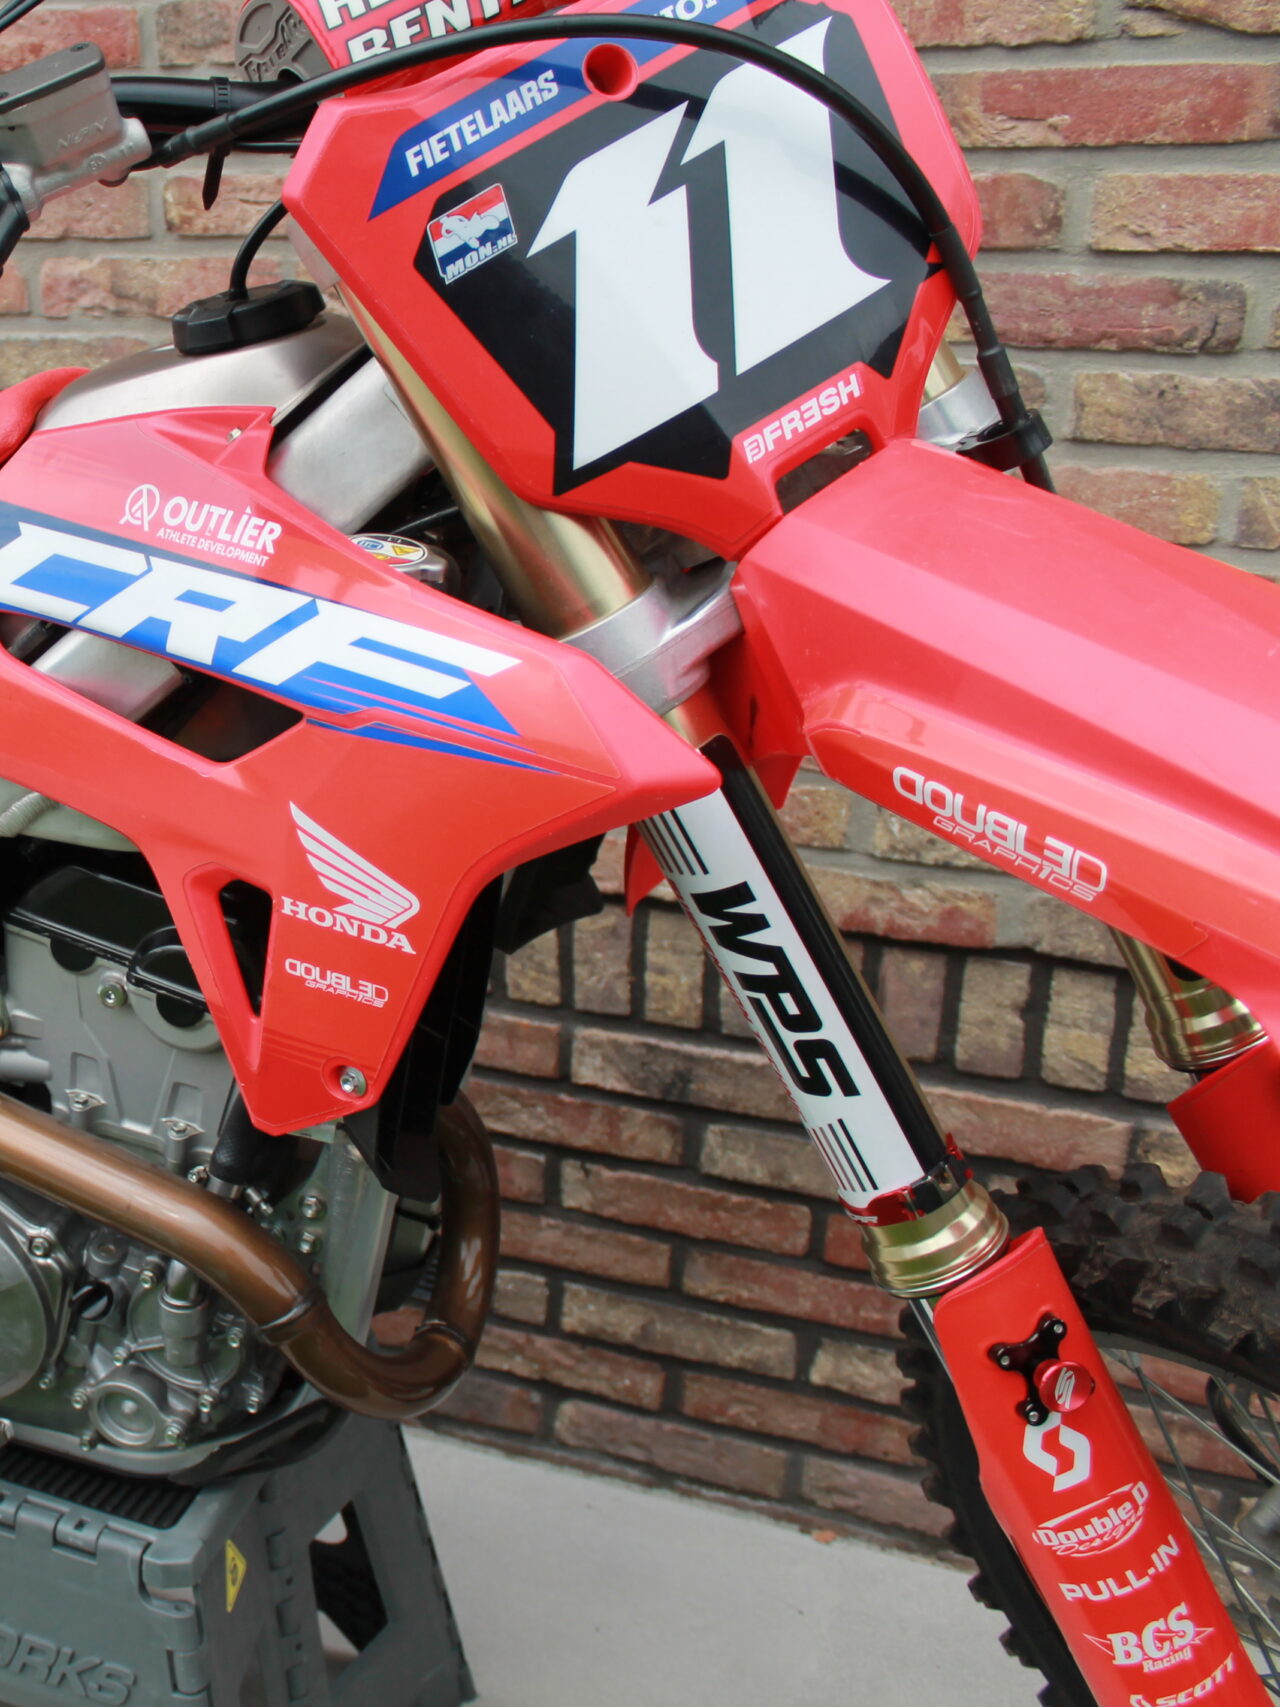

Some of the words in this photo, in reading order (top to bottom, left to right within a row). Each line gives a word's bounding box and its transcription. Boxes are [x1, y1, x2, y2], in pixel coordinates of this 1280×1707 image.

[405, 69, 560, 178] FIETELAARS
[156, 527, 197, 550] ATHLETE
[197, 538, 269, 567] DEVELOPMENT
[933, 816, 1098, 902] GRAPHICS
[281, 896, 417, 955] HONDA
[305, 980, 385, 1008] GRAPHICS
[691, 880, 861, 1098] WPS
[1036, 1501, 1135, 1546] Double
[1131, 1481, 1149, 1506] D
[1058, 1534, 1180, 1601] PULL-IN
[1107, 1602, 1195, 1665] BCS
[1142, 1647, 1192, 1673] Racing
[1155, 1652, 1234, 1707] SCOTT
